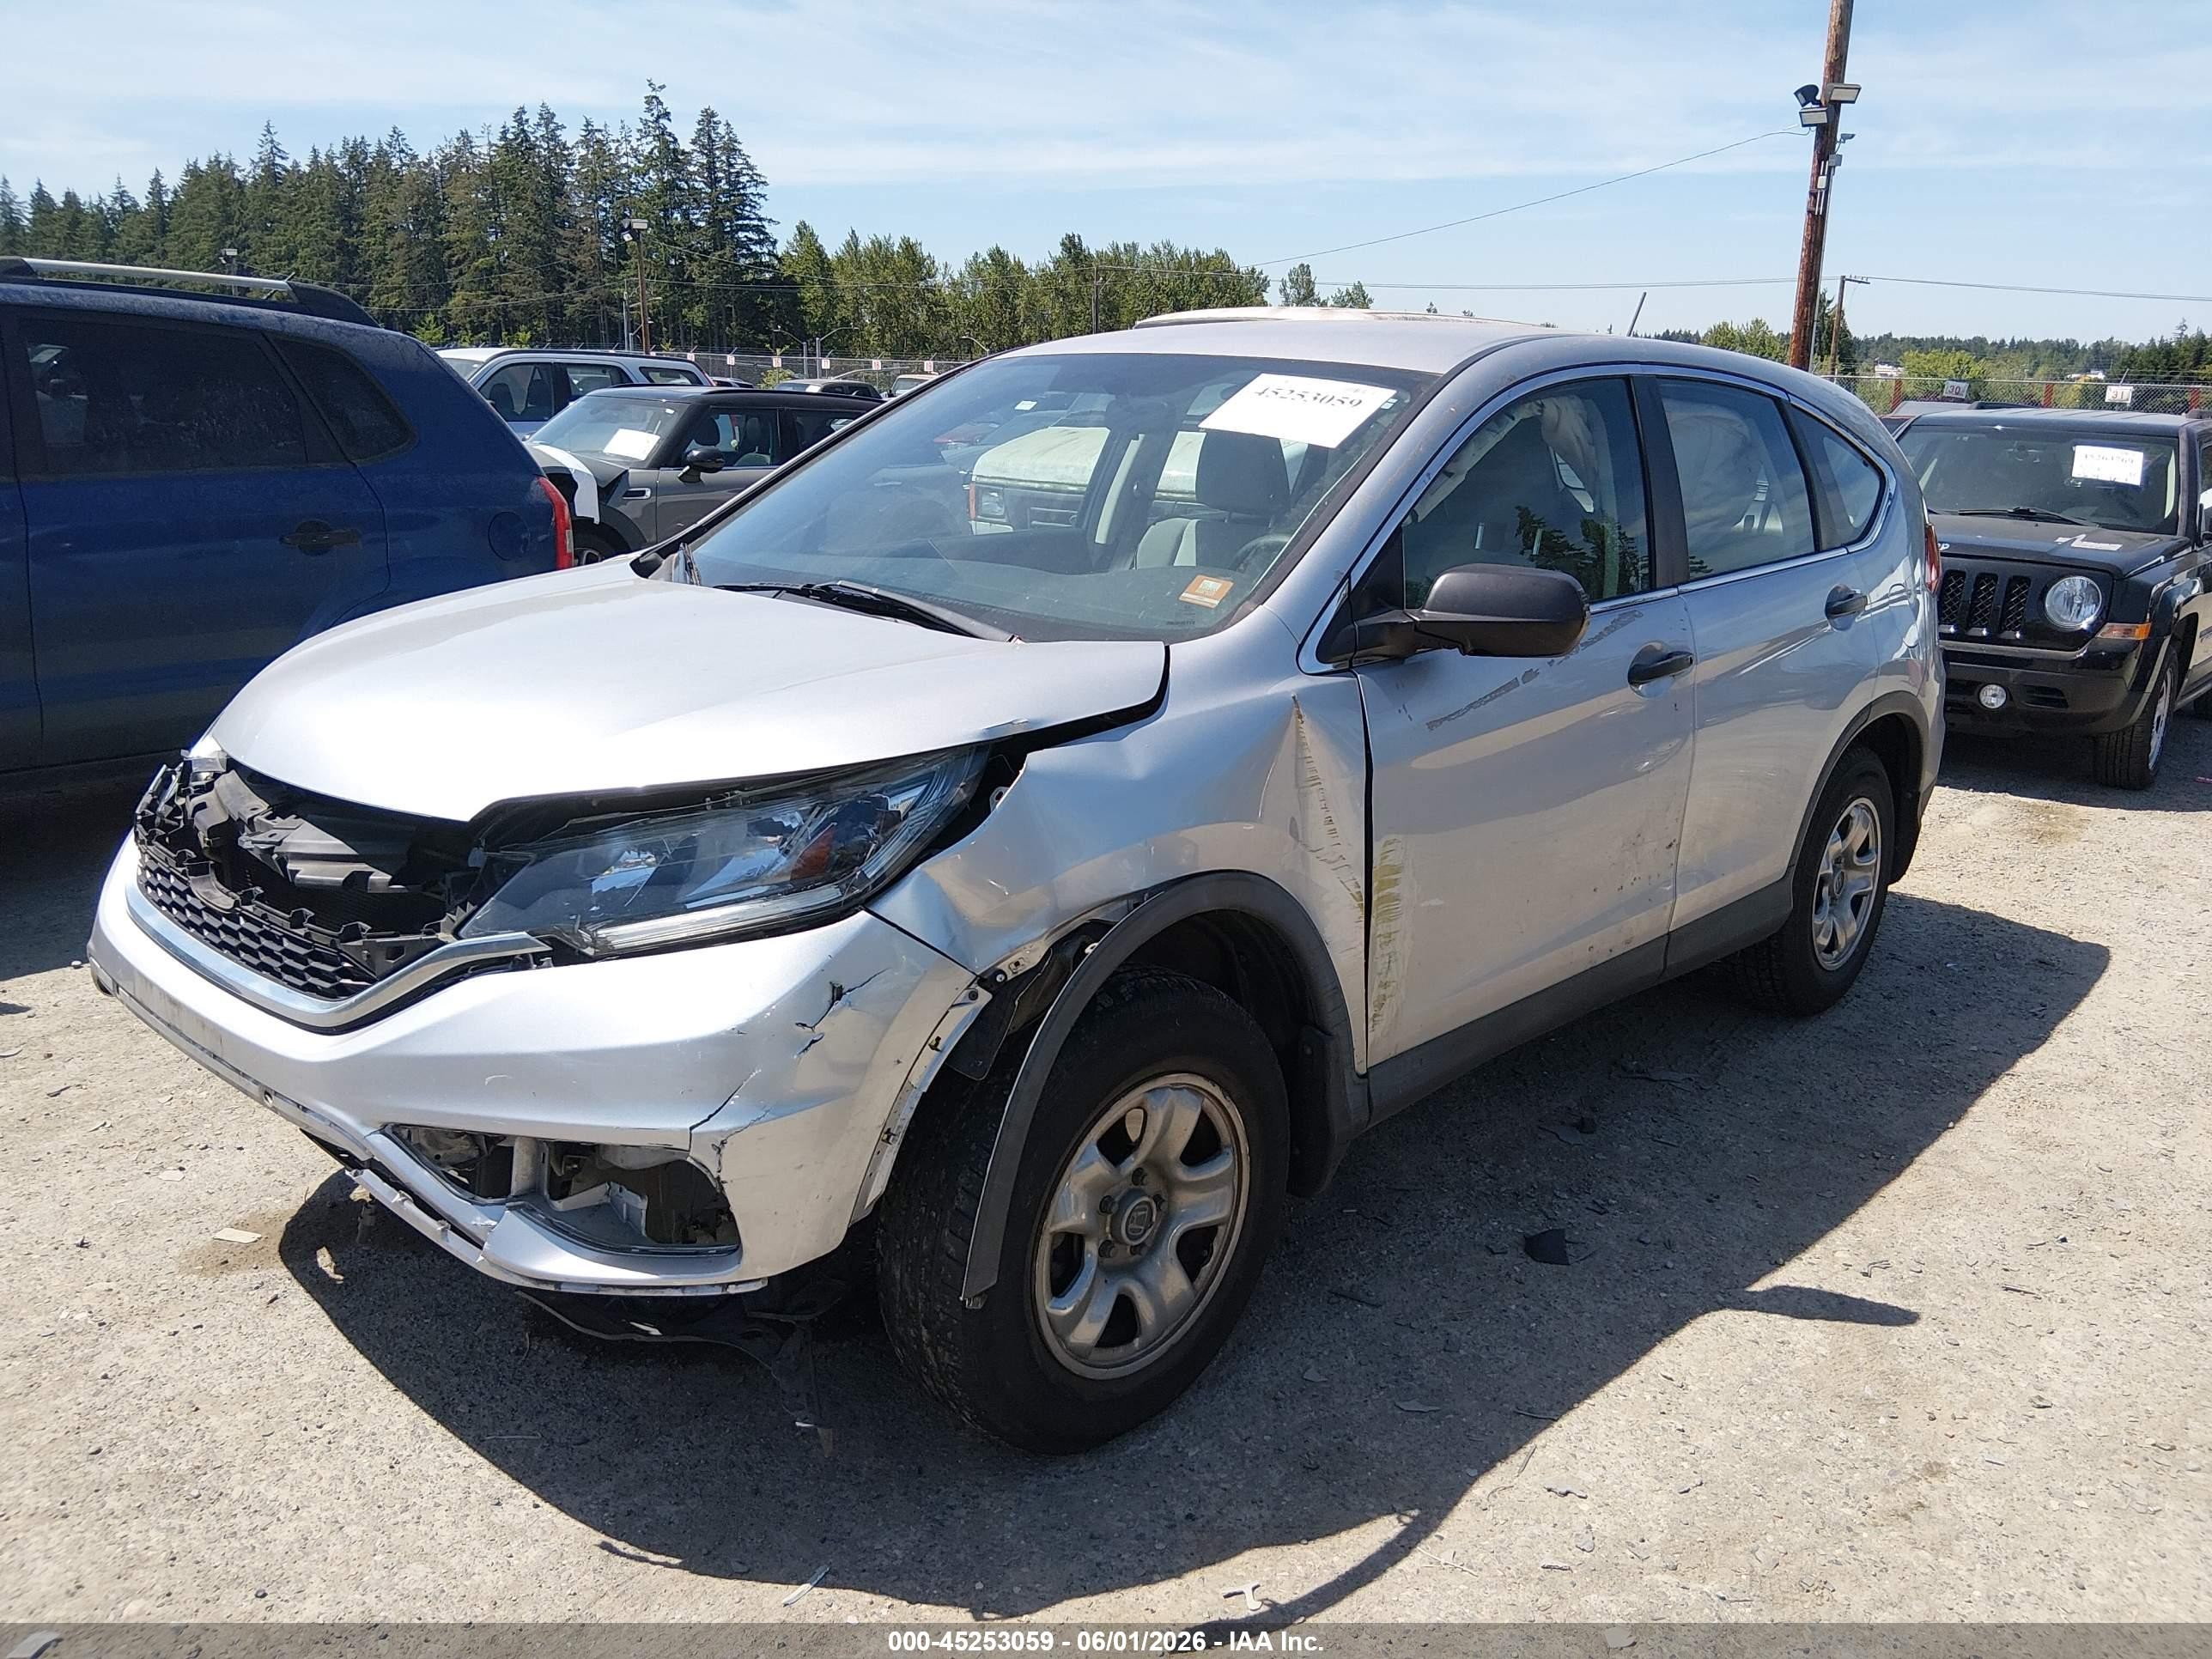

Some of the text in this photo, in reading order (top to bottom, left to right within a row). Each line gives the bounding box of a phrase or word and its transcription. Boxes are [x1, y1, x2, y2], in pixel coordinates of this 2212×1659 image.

[1948, 385, 1961, 396] 30
[2112, 390, 2124, 399] 31
[1254, 386, 1363, 408] 45253059
